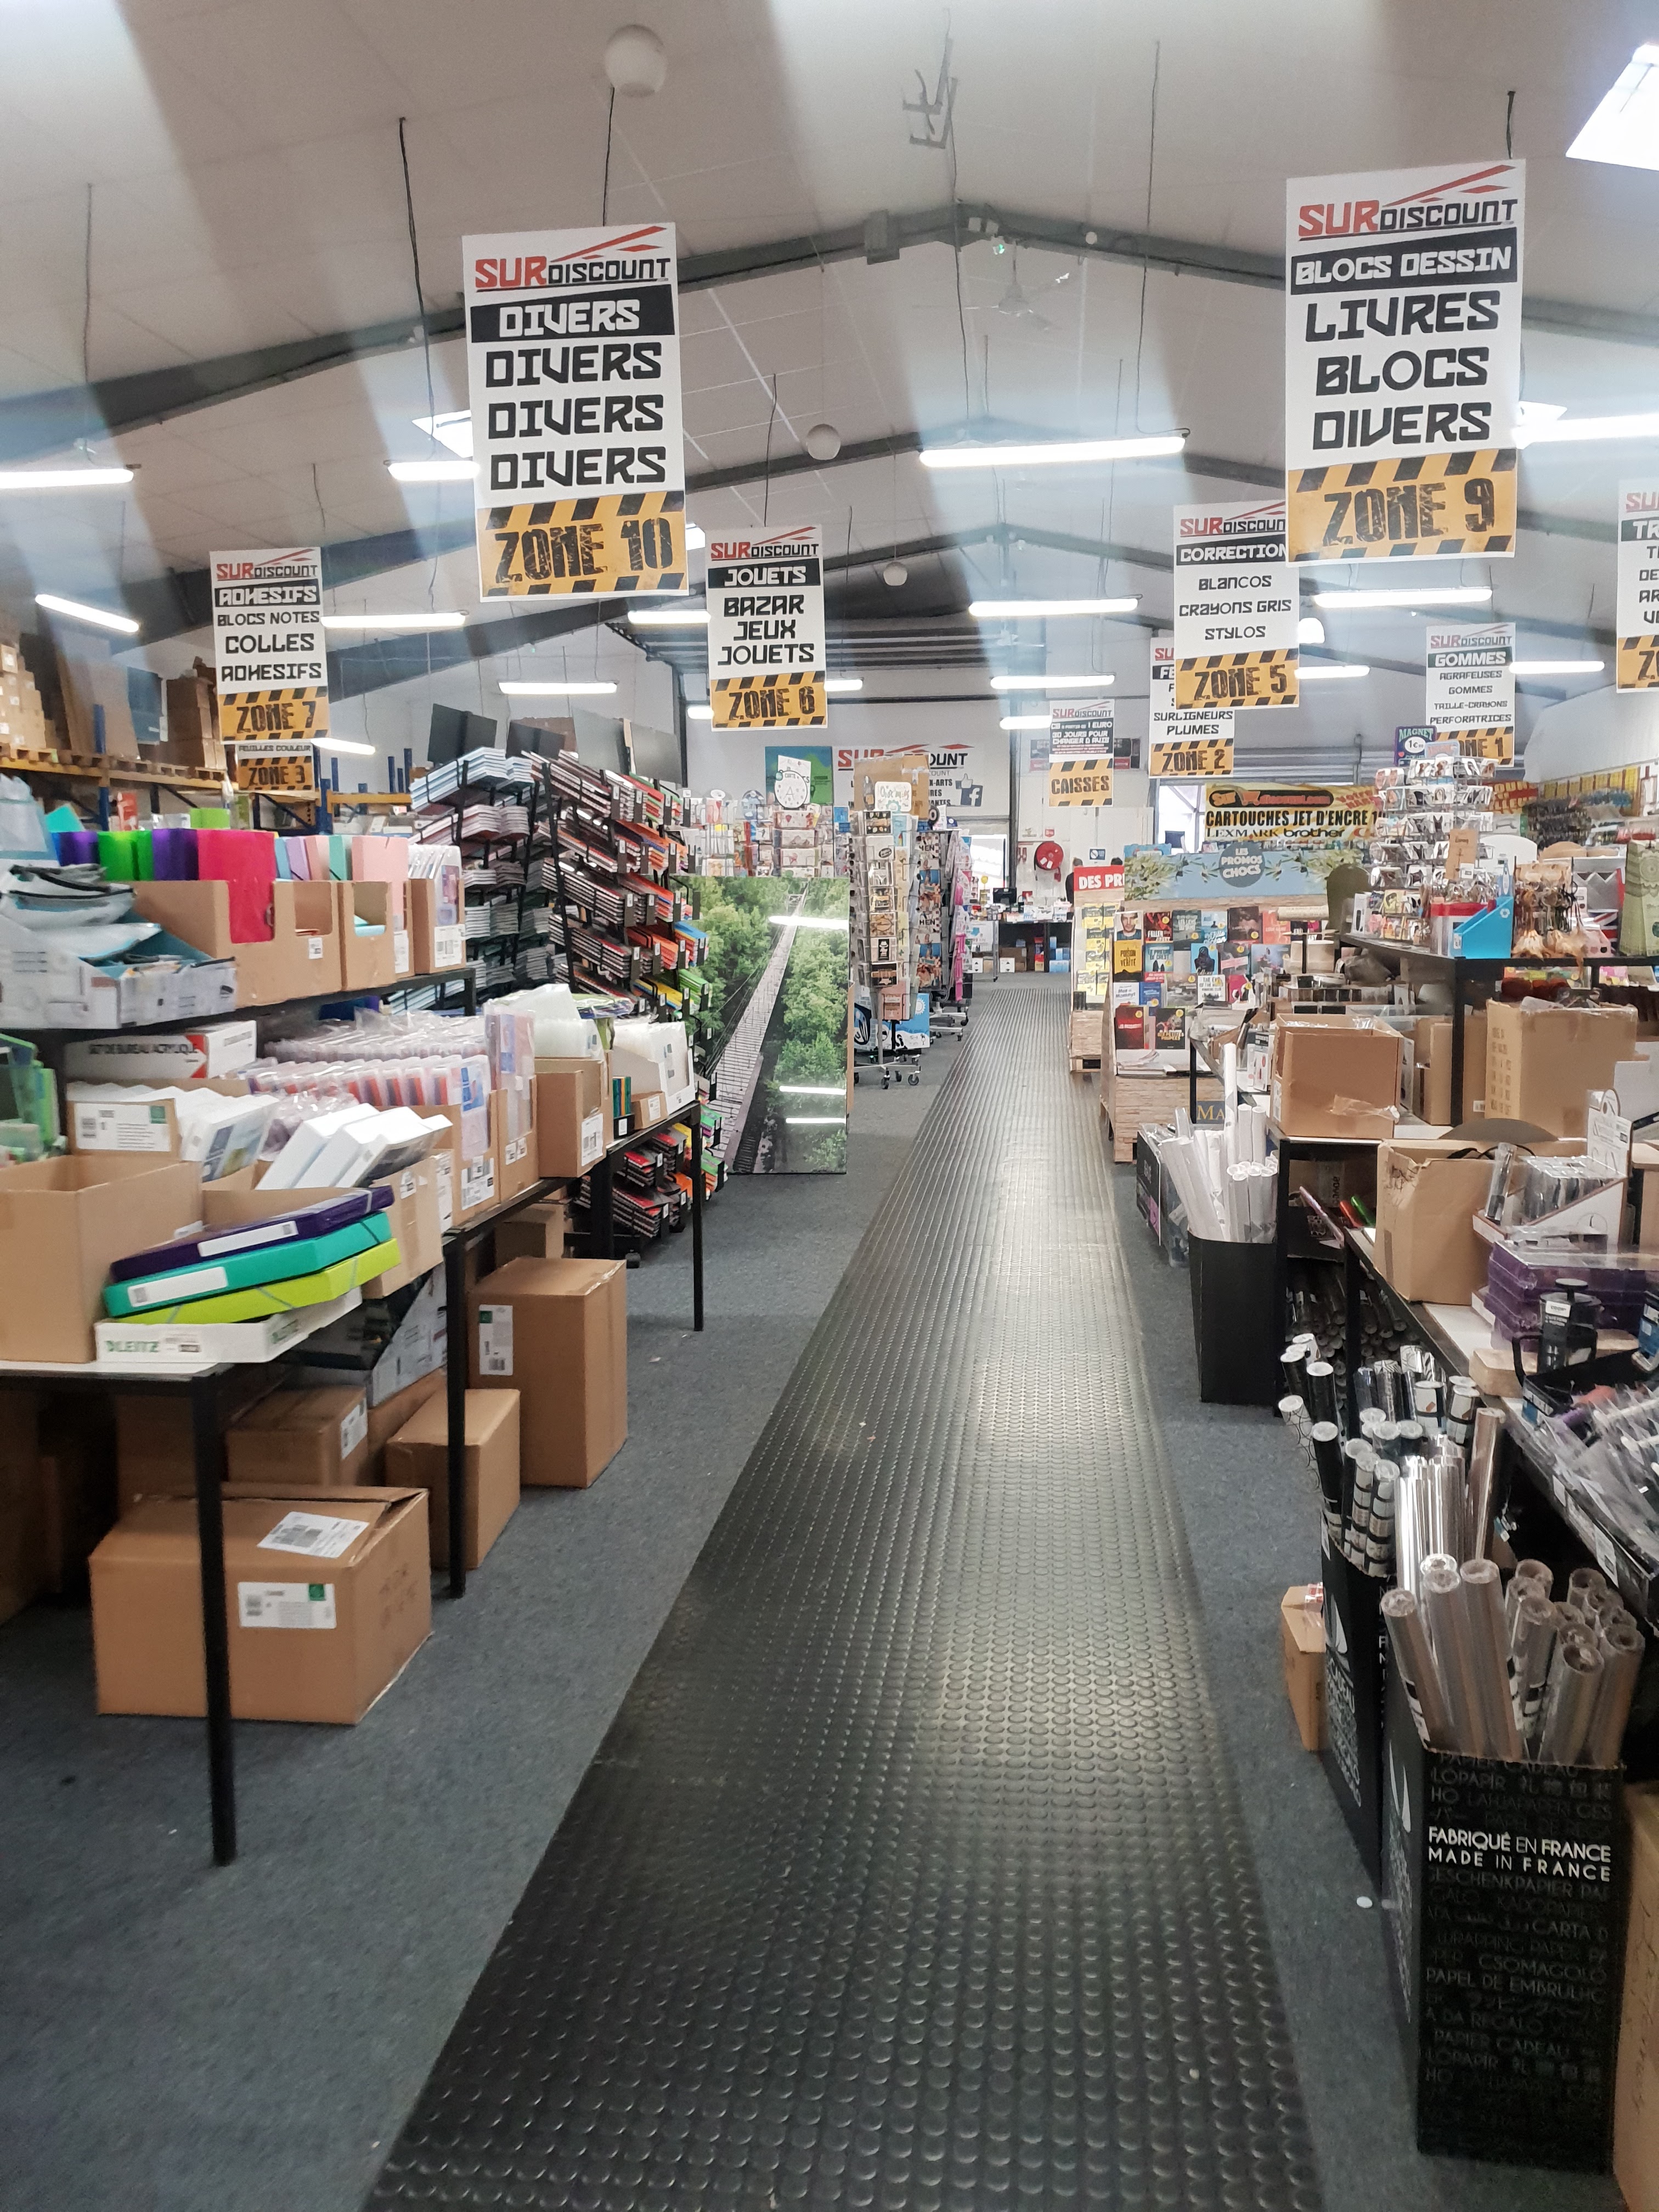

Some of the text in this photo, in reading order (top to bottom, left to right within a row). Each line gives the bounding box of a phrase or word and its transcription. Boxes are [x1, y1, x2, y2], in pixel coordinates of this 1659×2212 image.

[1296, 246, 1511, 285] BLOCS DESSIN
[499, 300, 640, 338] DIVERS
[1305, 290, 1500, 342] LIVRES
[486, 342, 662, 388] DIVERS
[1316, 347, 1489, 396] BLOCS
[488, 394, 664, 439] DIVERS
[1313, 402, 1492, 450] DIVERS
[490, 447, 666, 490] DIVERS
[1323, 478, 1494, 547] ZONE 9
[494, 517, 673, 584] ZONE 10
[724, 566, 806, 586] JOUETS
[1199, 575, 1272, 590] BLANCOS
[219, 586, 317, 606] ADHESIFS
[724, 594, 804, 617] BAZAR
[1179, 599, 1291, 617] CRAYONS GRIS
[217, 611, 320, 627] BLOCS NOTES
[733, 619, 796, 641] JEUX
[1205, 626, 1266, 640] STYLOS
[225, 633, 314, 654] COLLES
[718, 643, 815, 665] JOUETS
[1435, 651, 1506, 666] GOMMES
[222, 663, 322, 682] ADHESIFS
[1194, 664, 1286, 701] ZONE 5
[1440, 670, 1502, 680] AGRAFEUSES
[1448, 685, 1493, 695] GOMMES
[729, 686, 815, 721] ZONE 6
[1434, 700, 1508, 710] TAILLE-CRAYONS
[236, 701, 317, 733] ZONE 7
[1154, 711, 1233, 721] SURLIGNEURS
[1430, 714, 1511, 724] PERFORATRICES
[1167, 724, 1219, 735] PLUMES
[1399, 729, 1434, 742] MAGNET
[1495, 737, 1503, 757] 1
[1161, 749, 1225, 772] ZONE 2
[249, 765, 305, 786] ZONE 3
[1051, 775, 1109, 794] CAISSES
[1207, 810, 1289, 826] CARTOUCHES
[1293, 810, 1312, 826] JET
[1317, 810, 1368, 826] D'ENCRE
[1284, 828, 1345, 837] brother
[1221, 856, 1262, 865] PROMOS
[1079, 875, 1102, 889] DES
[1222, 865, 1261, 879] CHOCS
[1429, 1825, 1611, 1863] FABRIQUÉ EN FRANCE
[1428, 1846, 1611, 1882] MADE IN FRANCE
